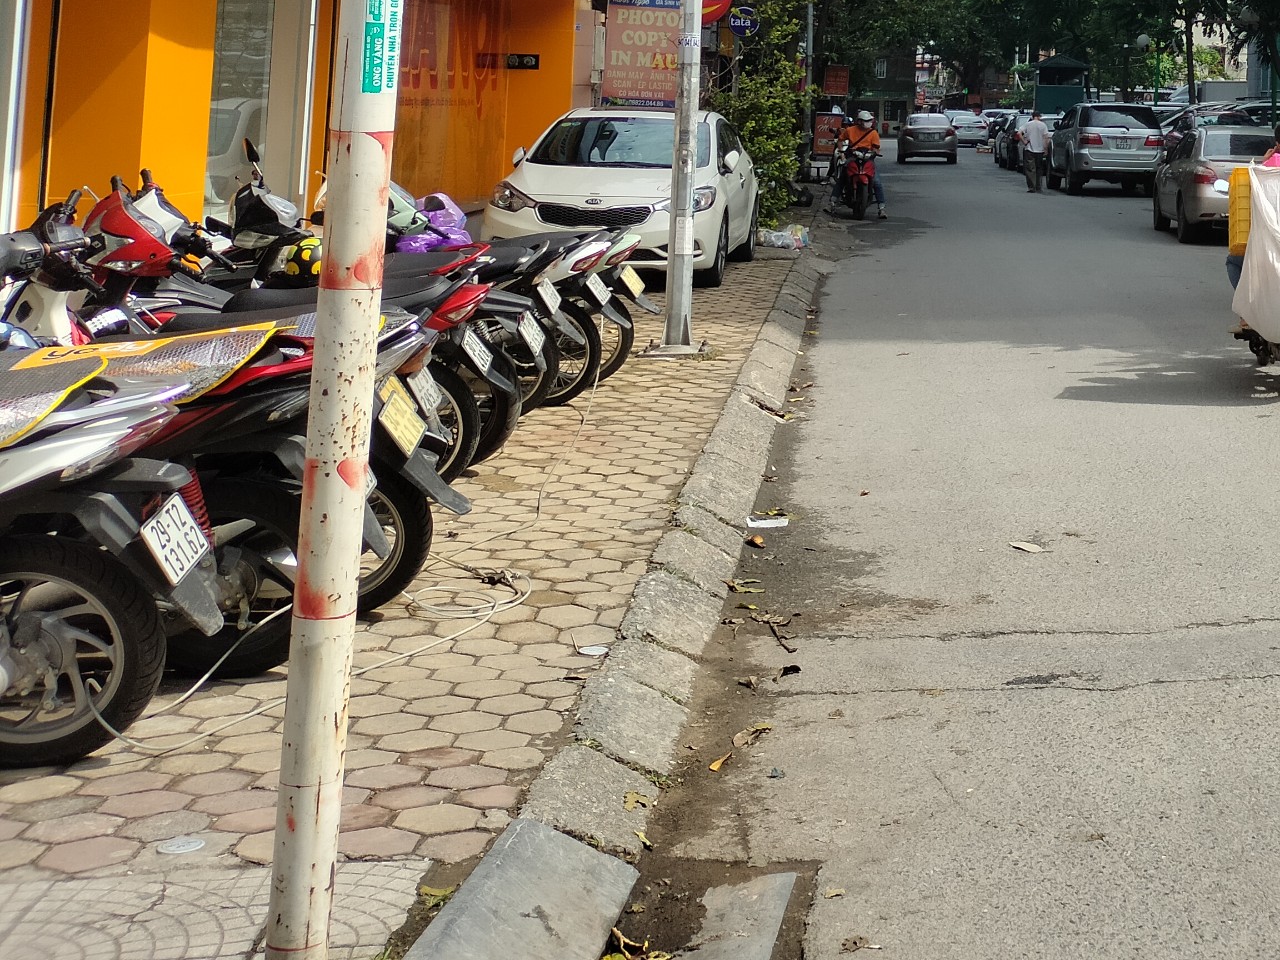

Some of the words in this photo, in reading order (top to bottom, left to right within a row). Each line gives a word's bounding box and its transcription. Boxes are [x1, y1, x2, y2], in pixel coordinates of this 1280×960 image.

[389, 11, 398, 33] TRỌN
[616, 8, 678, 28] PHOTO
[730, 16, 751, 27] tata
[387, 35, 397, 52] NHÀ
[622, 29, 672, 48] COPY
[372, 37, 383, 65] VÀNG
[610, 50, 632, 66] IN
[636, 48, 678, 70] MÀU
[372, 65, 381, 87] ONG
[384, 55, 395, 88] CHUYỂN
[612, 80, 632, 89] SCAN
[648, 82, 672, 90] LASTIC
[42, 340, 156, 360] yody
[151, 504, 187, 550] 29-T2
[165, 526, 205, 577] 131.62
